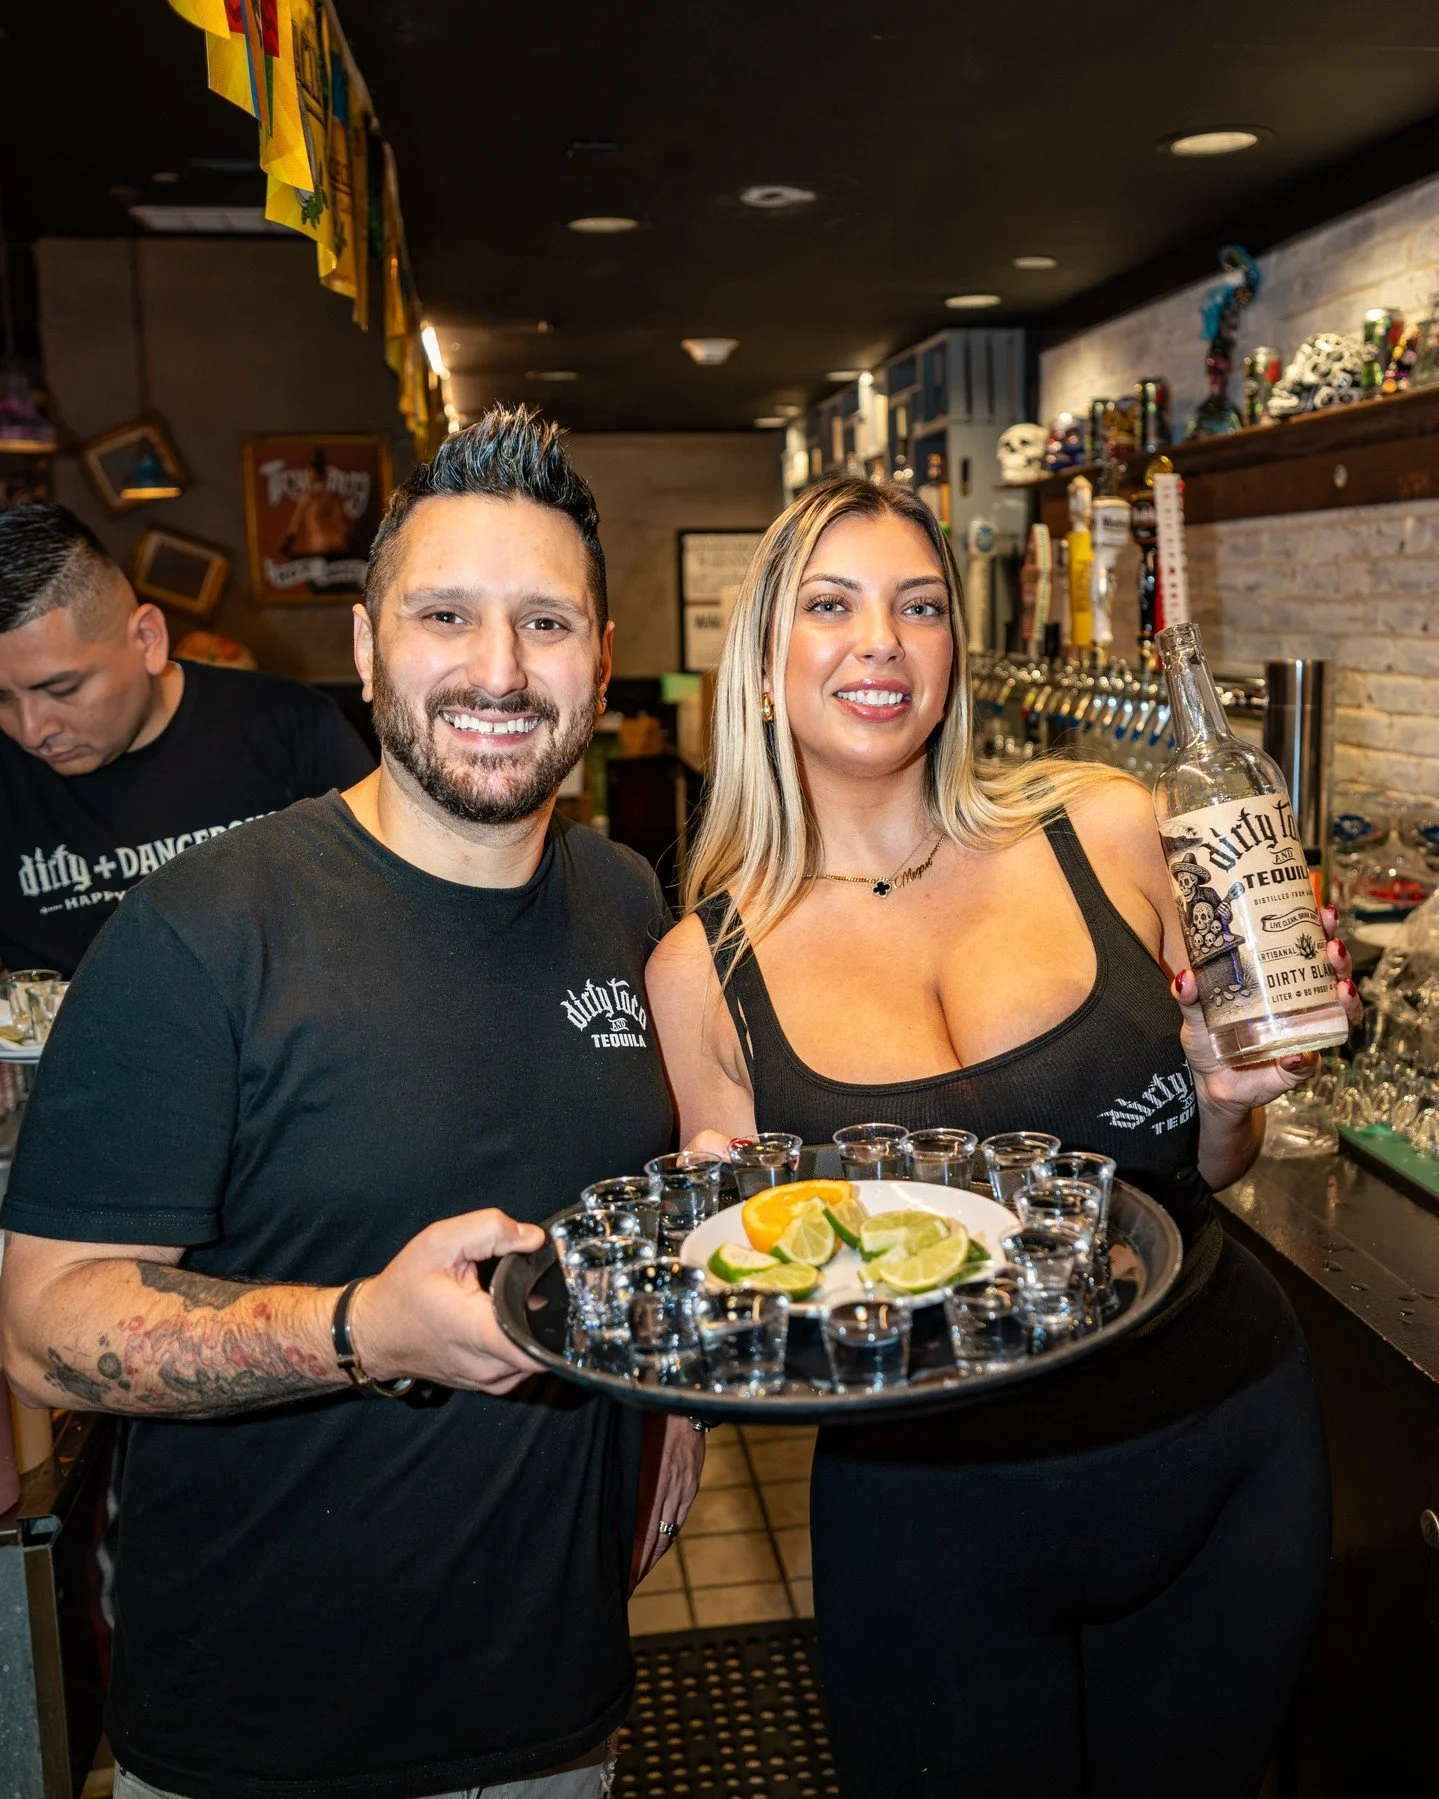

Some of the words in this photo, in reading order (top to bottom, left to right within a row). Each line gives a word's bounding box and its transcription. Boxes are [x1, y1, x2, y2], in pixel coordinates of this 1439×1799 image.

[1200, 807, 1279, 874] dirty
[1274, 849, 1294, 863] AND
[18, 844, 93, 897] dirty
[93, 855, 118, 880] +
[1254, 892, 1289, 906] DISTILLED
[1266, 967, 1306, 988] DIRTY
[560, 979, 615, 1032] dirty
[1271, 992, 1293, 1003] LITER
[591, 1033, 647, 1048] TEQUILA
[1097, 1073, 1189, 1130] dirty
